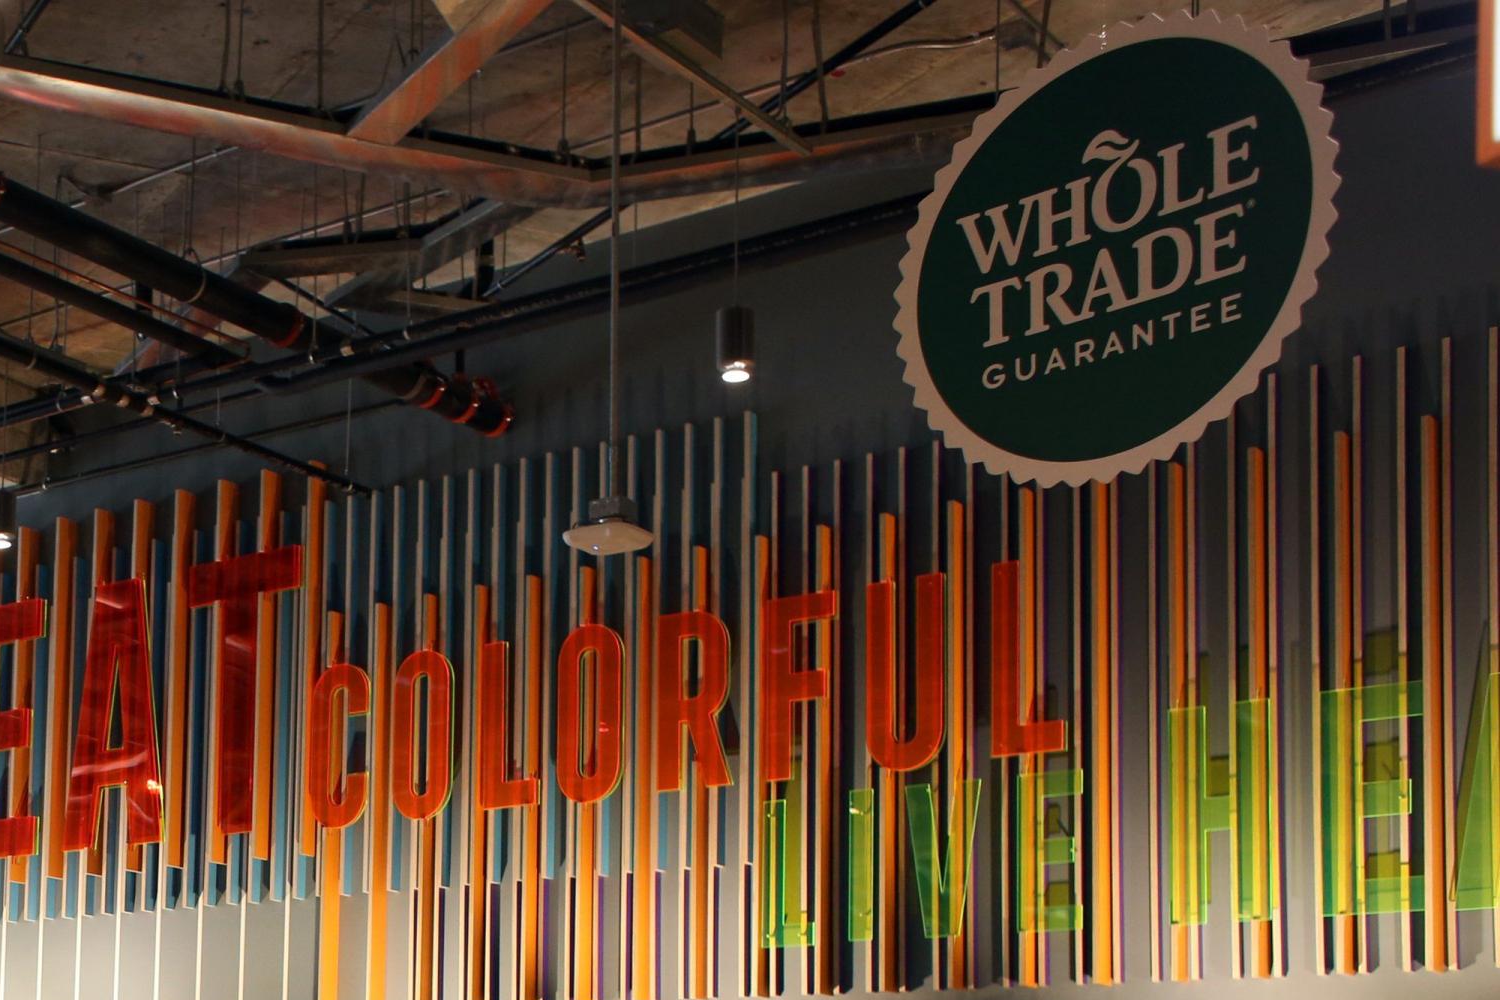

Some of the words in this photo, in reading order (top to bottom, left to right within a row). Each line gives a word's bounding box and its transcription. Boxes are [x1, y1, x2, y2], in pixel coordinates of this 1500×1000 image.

[956, 116, 1260, 275] WHOLE
[969, 204, 1248, 348] TRADE
[981, 293, 1243, 389] GUARANTEE
[309, 559, 1069, 828] COLORFUL
[761, 768, 1084, 949] LIVE
